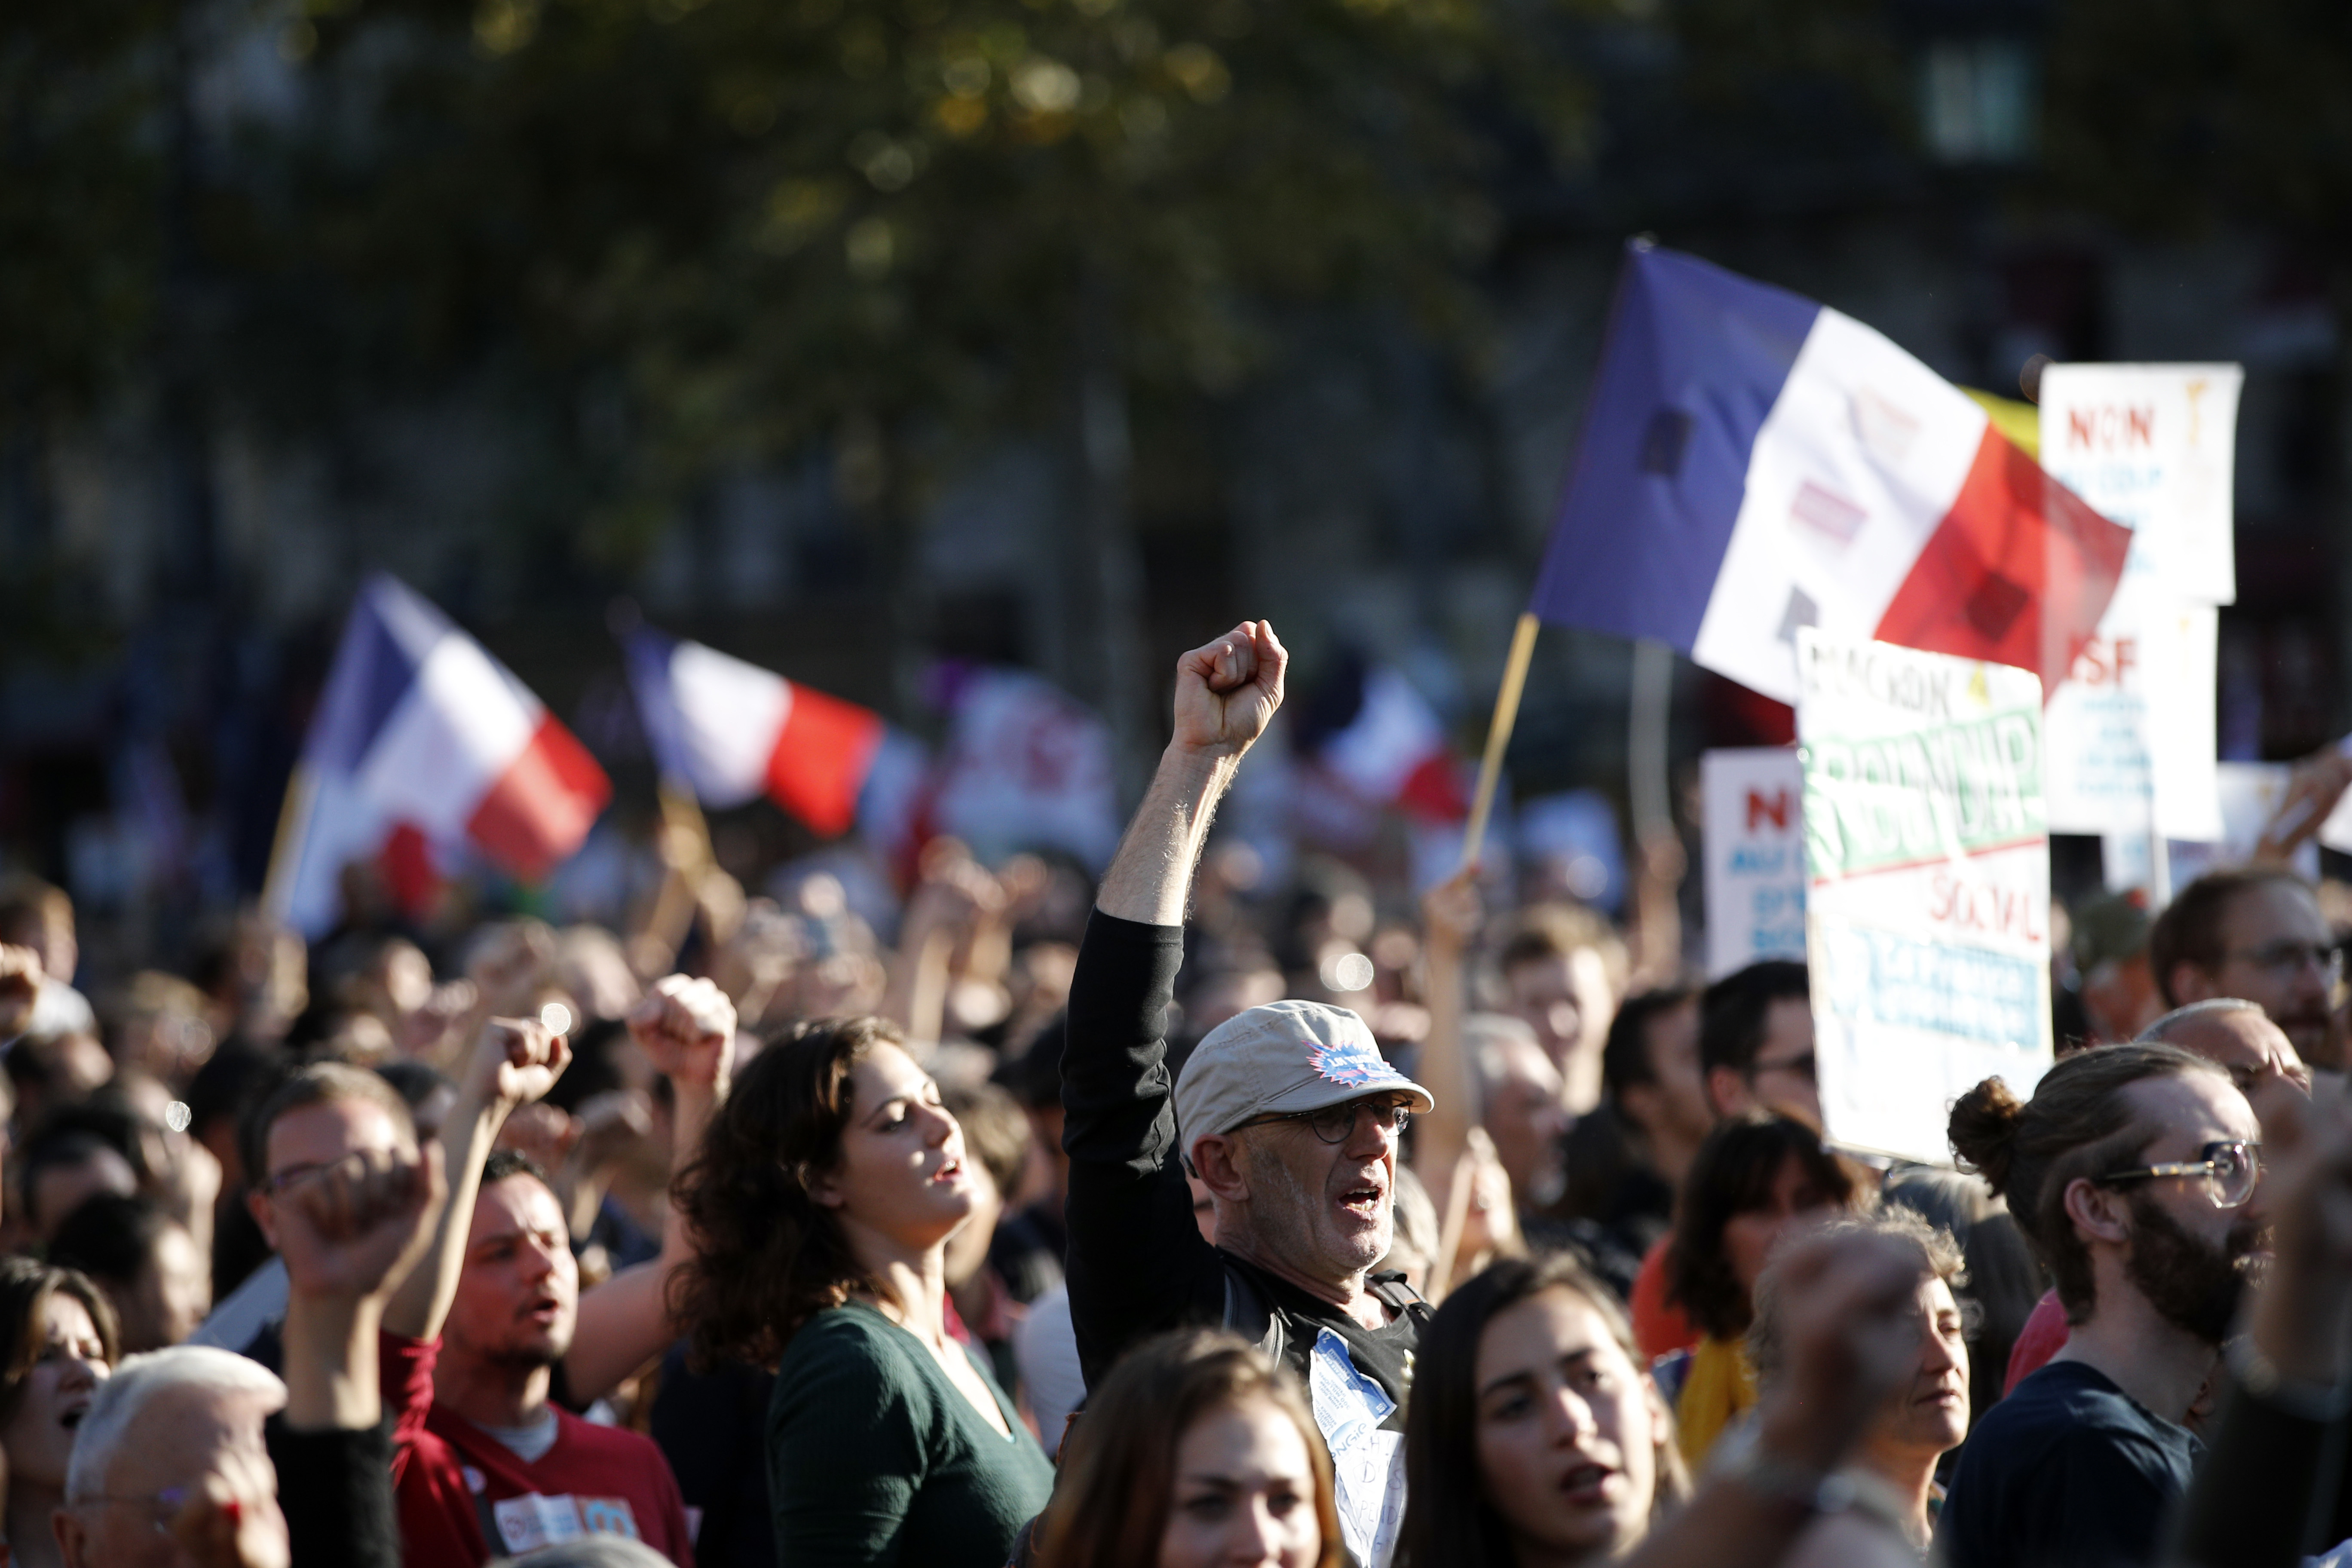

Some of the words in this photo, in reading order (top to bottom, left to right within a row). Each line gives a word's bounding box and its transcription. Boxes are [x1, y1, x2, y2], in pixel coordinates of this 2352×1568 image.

[2066, 401, 2156, 453] NON
[1928, 873, 2042, 944] SOCIAL
[1327, 1057, 1348, 1067] LOI
[1317, 1371, 1341, 1398] MILLIONS
[1319, 1380, 1344, 1409] REMBOURSER
[1326, 1395, 1340, 1410] ENGIE
[1339, 1397, 1351, 1410] 300
